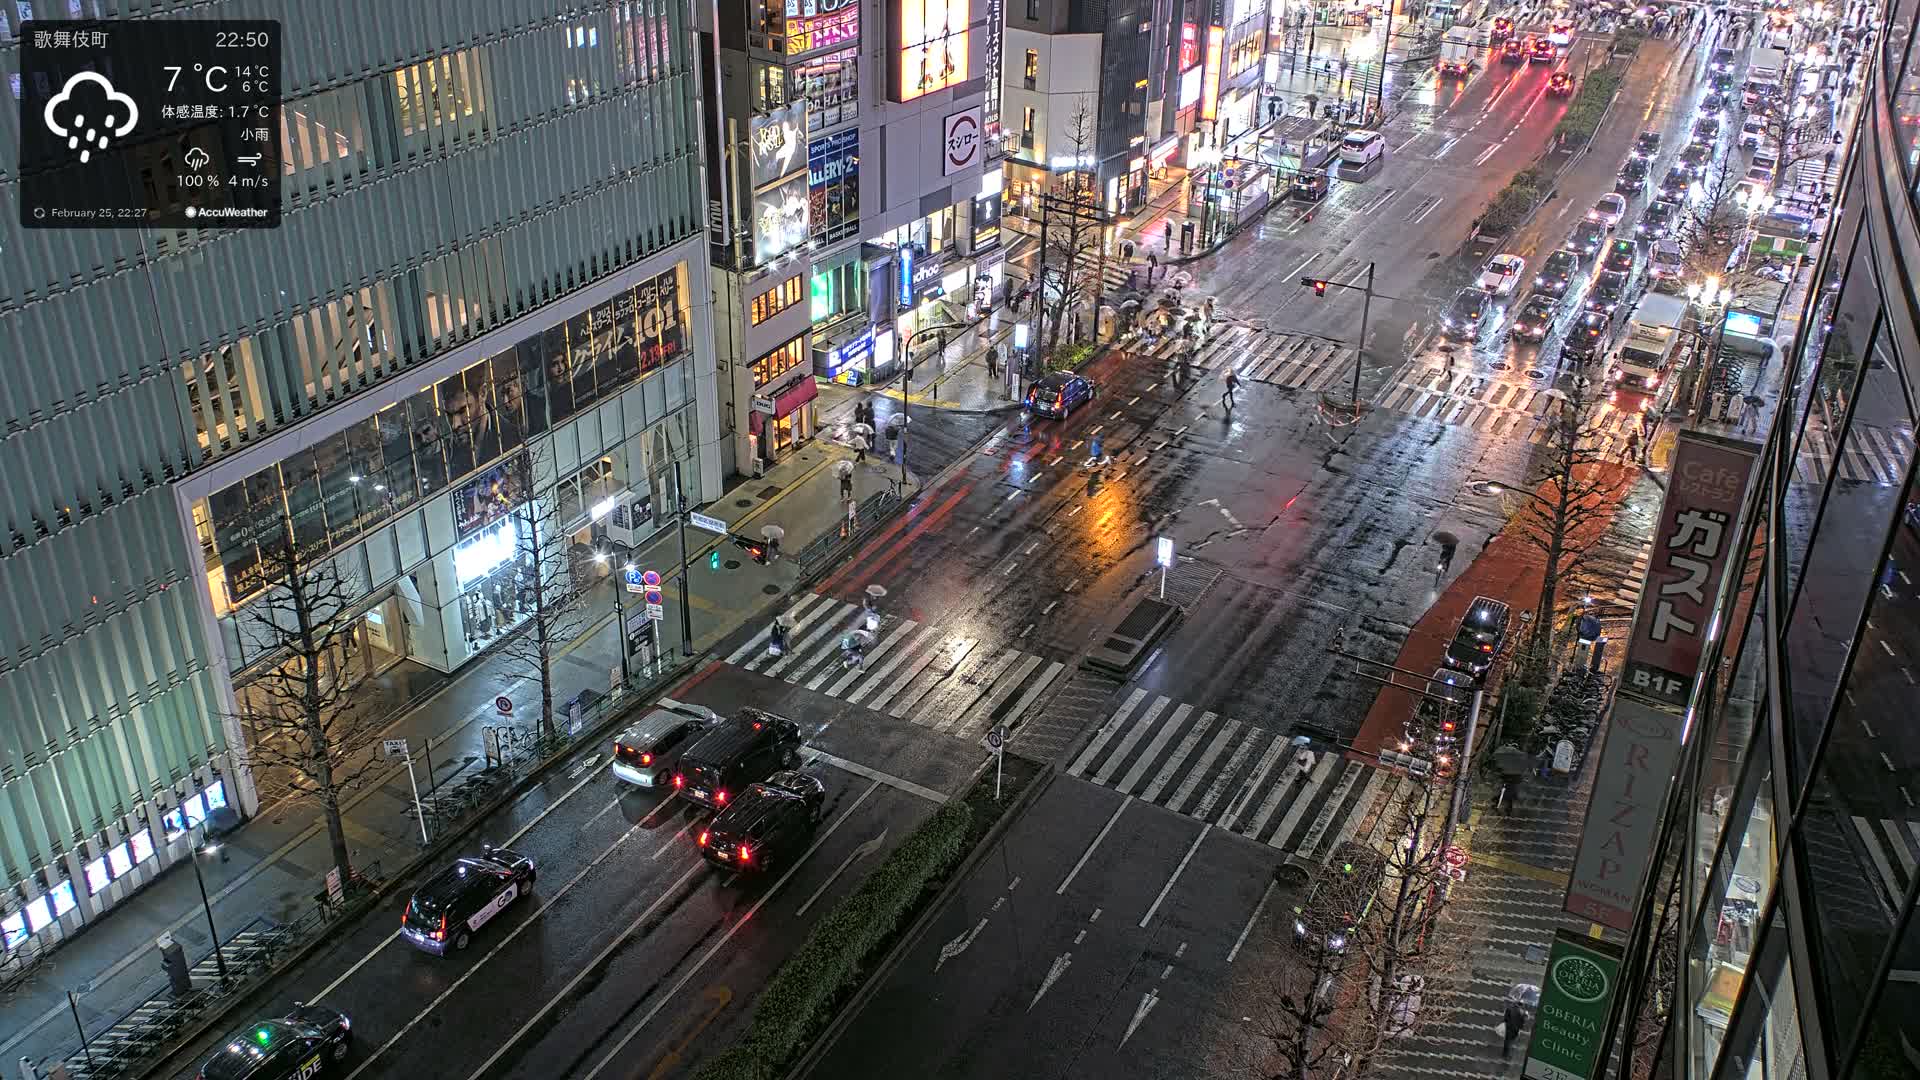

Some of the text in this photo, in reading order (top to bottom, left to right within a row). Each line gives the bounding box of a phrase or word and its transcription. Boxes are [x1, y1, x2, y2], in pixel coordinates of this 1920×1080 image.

[947, 131, 979, 152] スシロー
[710, 199, 722, 233] MUJI
[1651, 510, 1726, 642] ガスト
[1632, 669, 1682, 695] B1F
[1597, 743, 1649, 881] RIZAP
[1560, 969, 1600, 991] OBERIA
[1543, 1004, 1597, 1032] OBERIA
[1543, 1020, 1591, 1047] Beauty
[1541, 1039, 1583, 1061] Clinic
[1542, 1067, 1568, 1080] 2F
